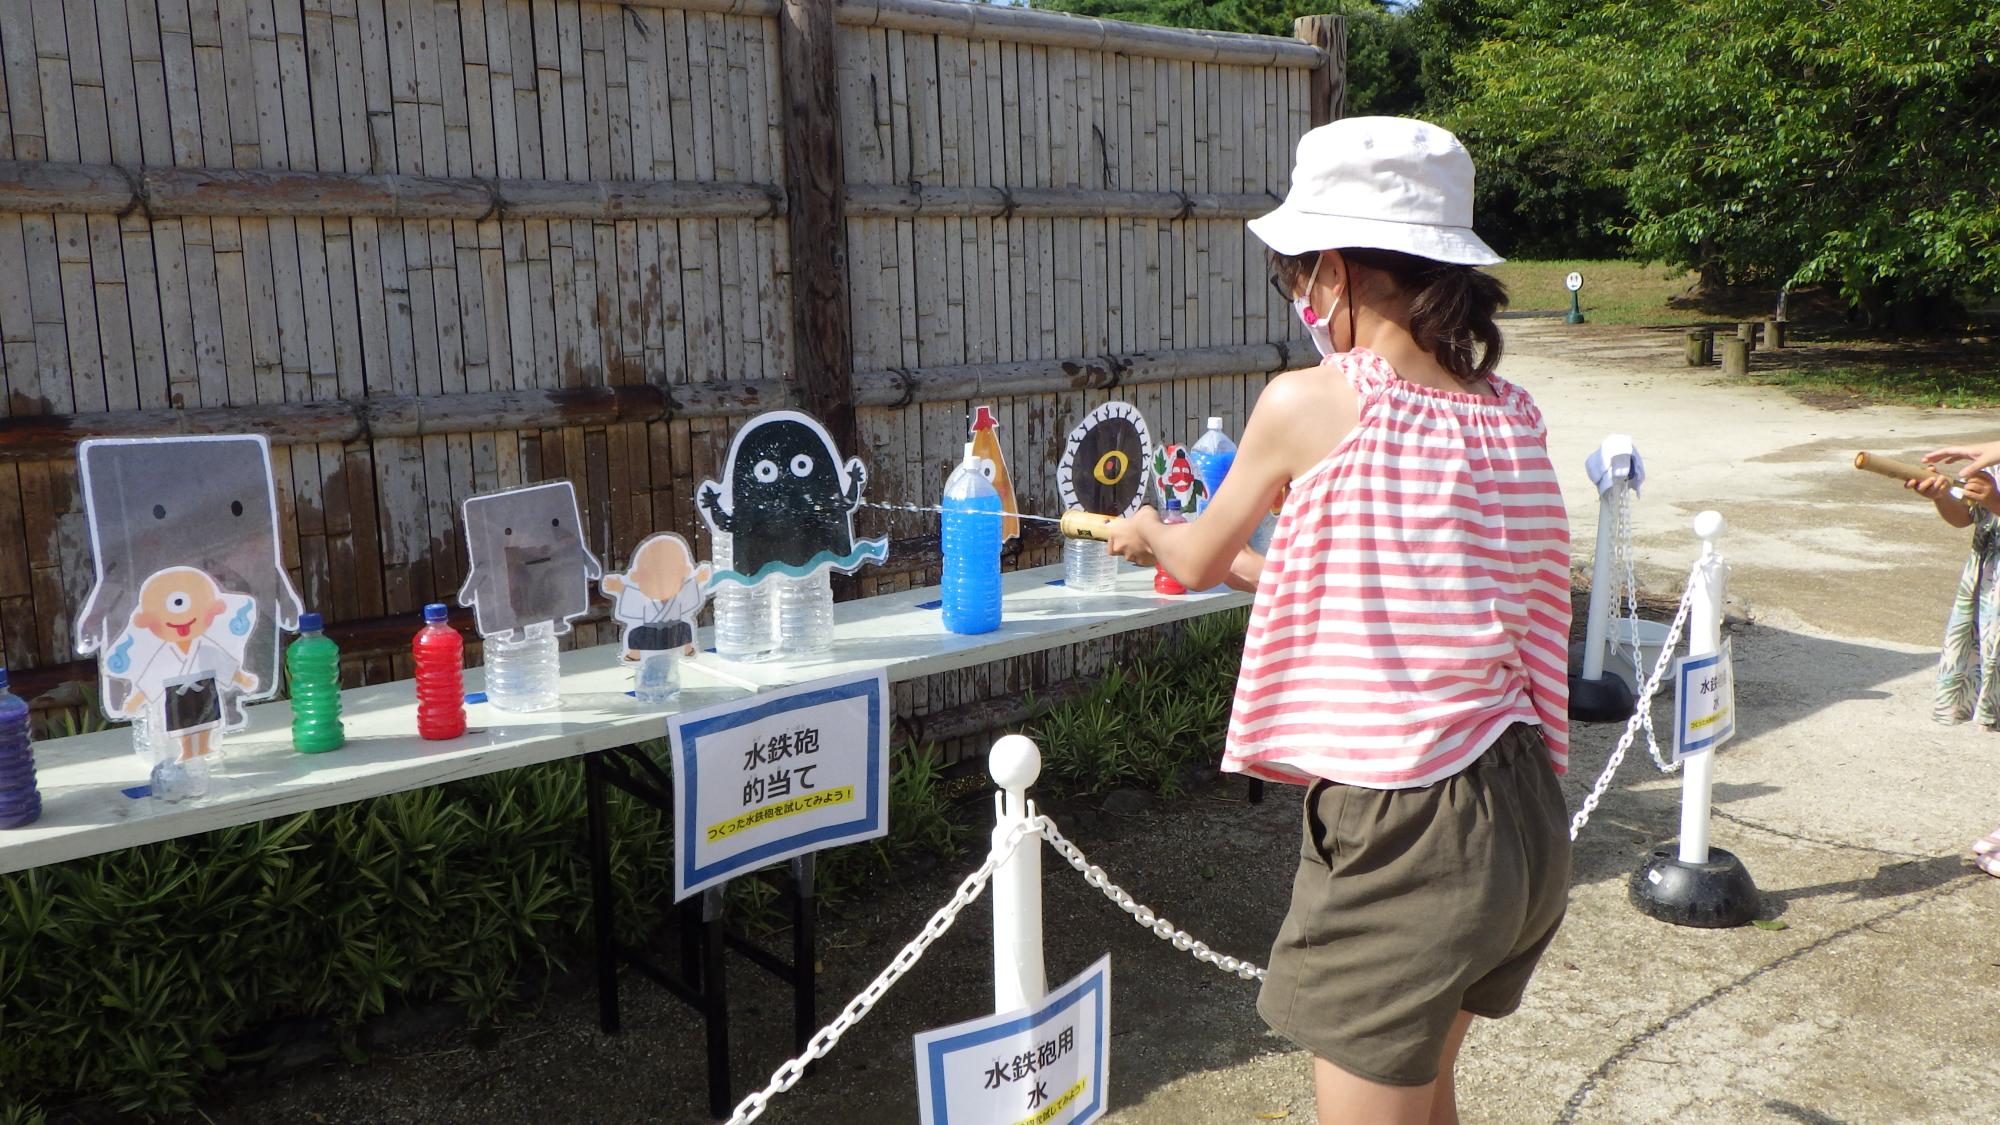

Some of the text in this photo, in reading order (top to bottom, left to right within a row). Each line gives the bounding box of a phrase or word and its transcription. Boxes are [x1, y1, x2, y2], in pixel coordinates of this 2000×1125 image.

[743, 728, 820, 771] 水鉄砲
[743, 764, 817, 806] 的当て
[984, 1026, 1073, 1089] 水鉄砲用
[1027, 1081, 1048, 1110] 水
